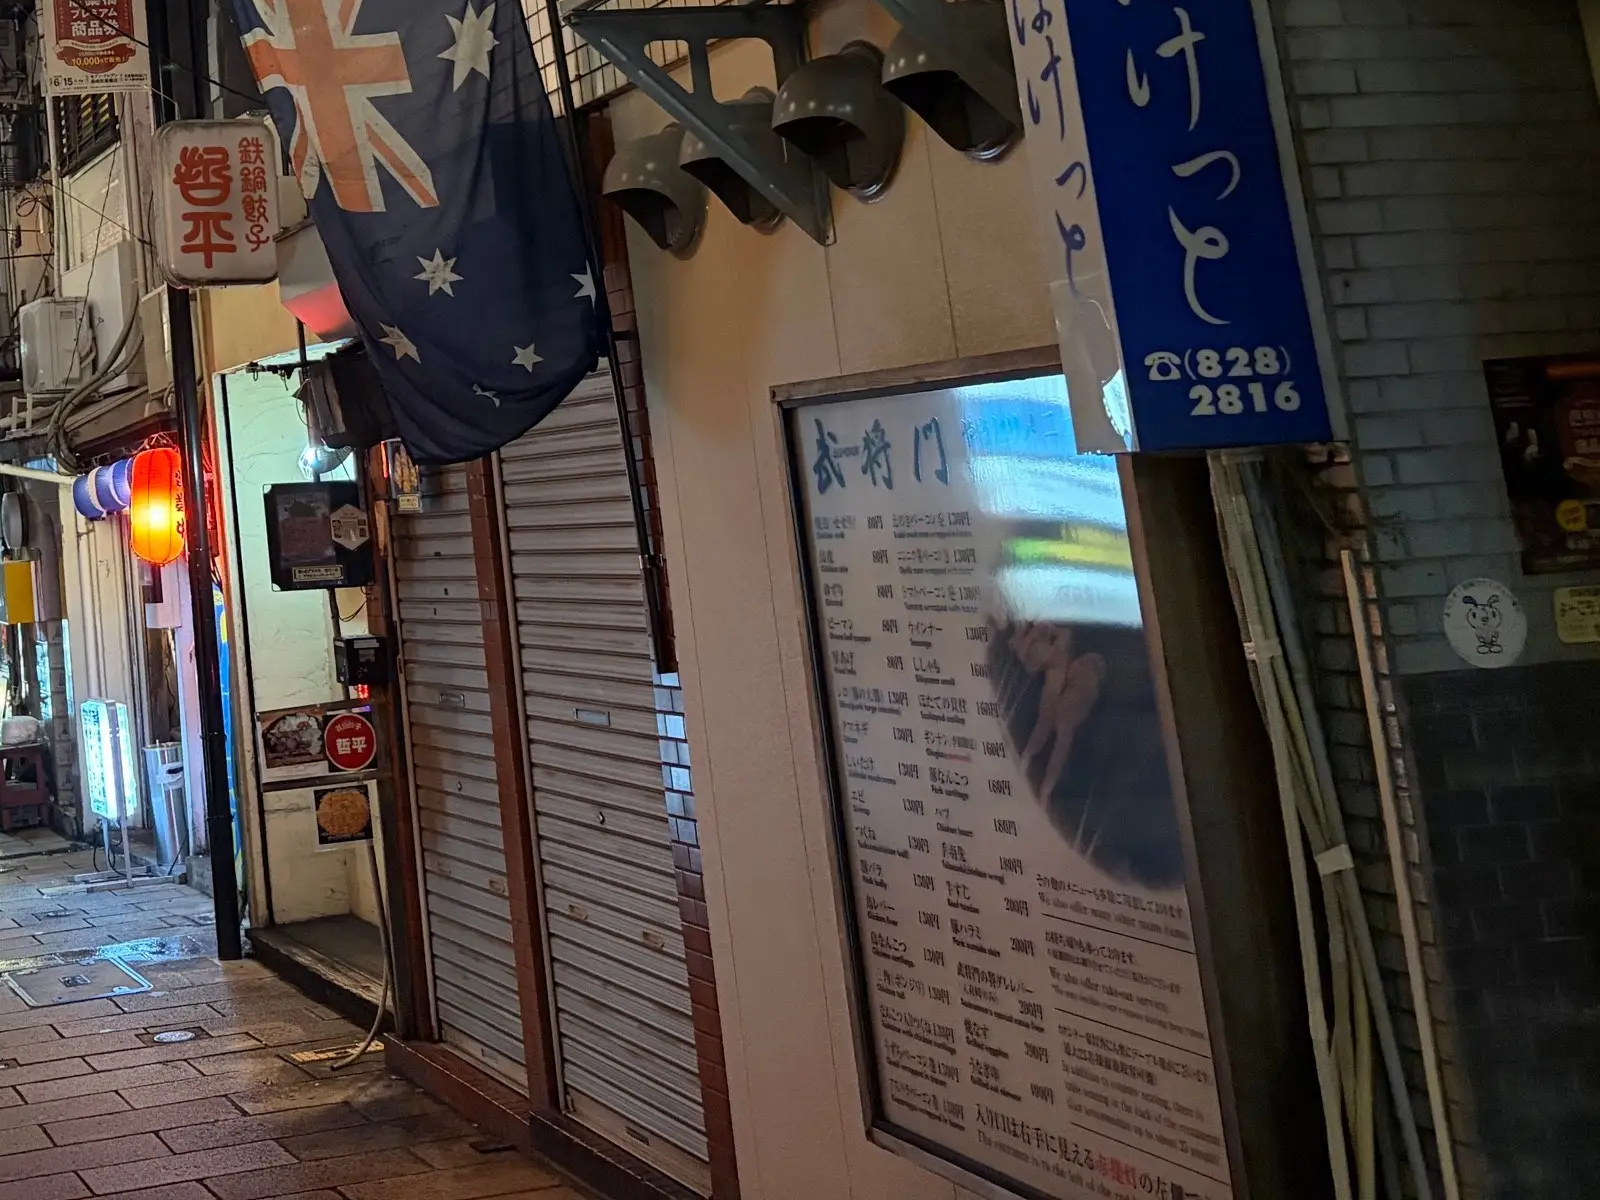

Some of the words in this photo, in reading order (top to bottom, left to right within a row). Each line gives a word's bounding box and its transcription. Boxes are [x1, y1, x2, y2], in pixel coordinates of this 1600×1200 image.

[238, 136, 270, 253] 鉄鍋餃子
[1185, 344, 1291, 381] (828)
[1190, 381, 1301, 417] 2816
[811, 414, 949, 495] 武将門
